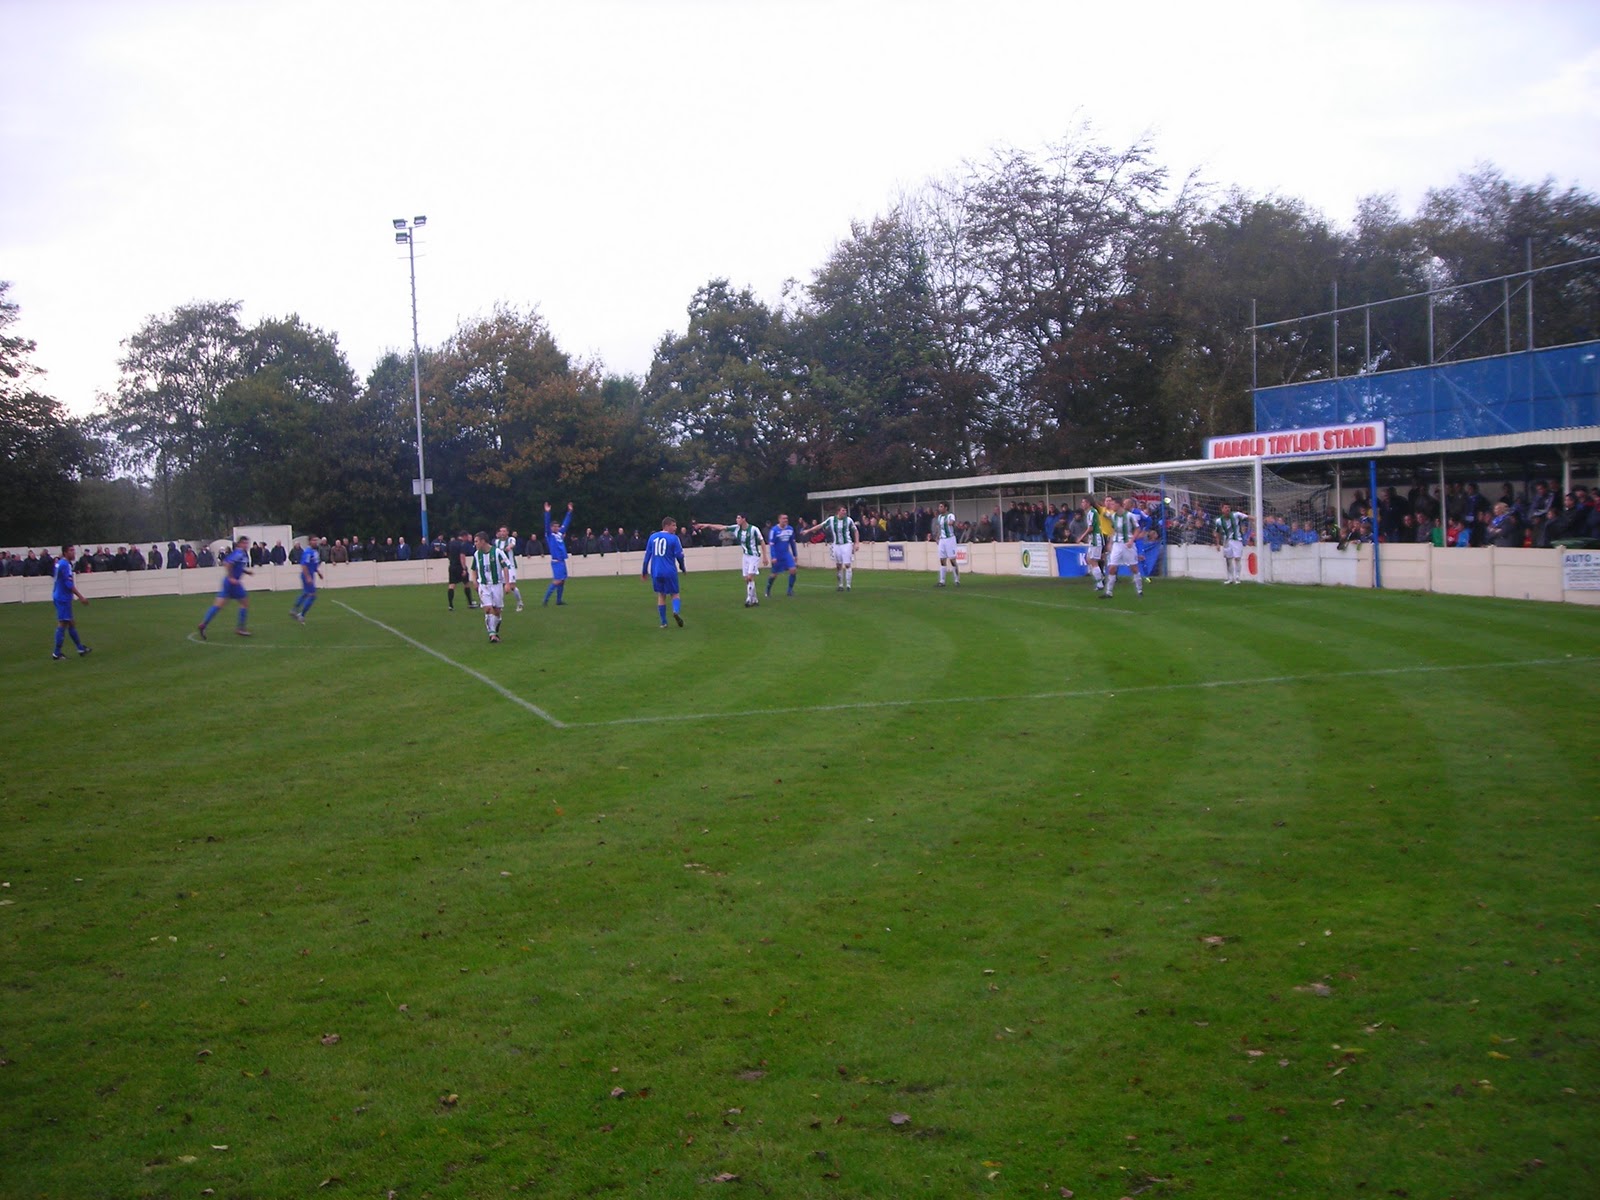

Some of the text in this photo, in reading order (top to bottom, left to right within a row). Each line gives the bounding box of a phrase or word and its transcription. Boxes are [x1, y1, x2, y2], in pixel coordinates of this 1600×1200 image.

[1213, 426, 1376, 459] HAROLD TAYLOR STAND
[653, 537, 667, 557] 10
[1565, 554, 1592, 563] AUTO
